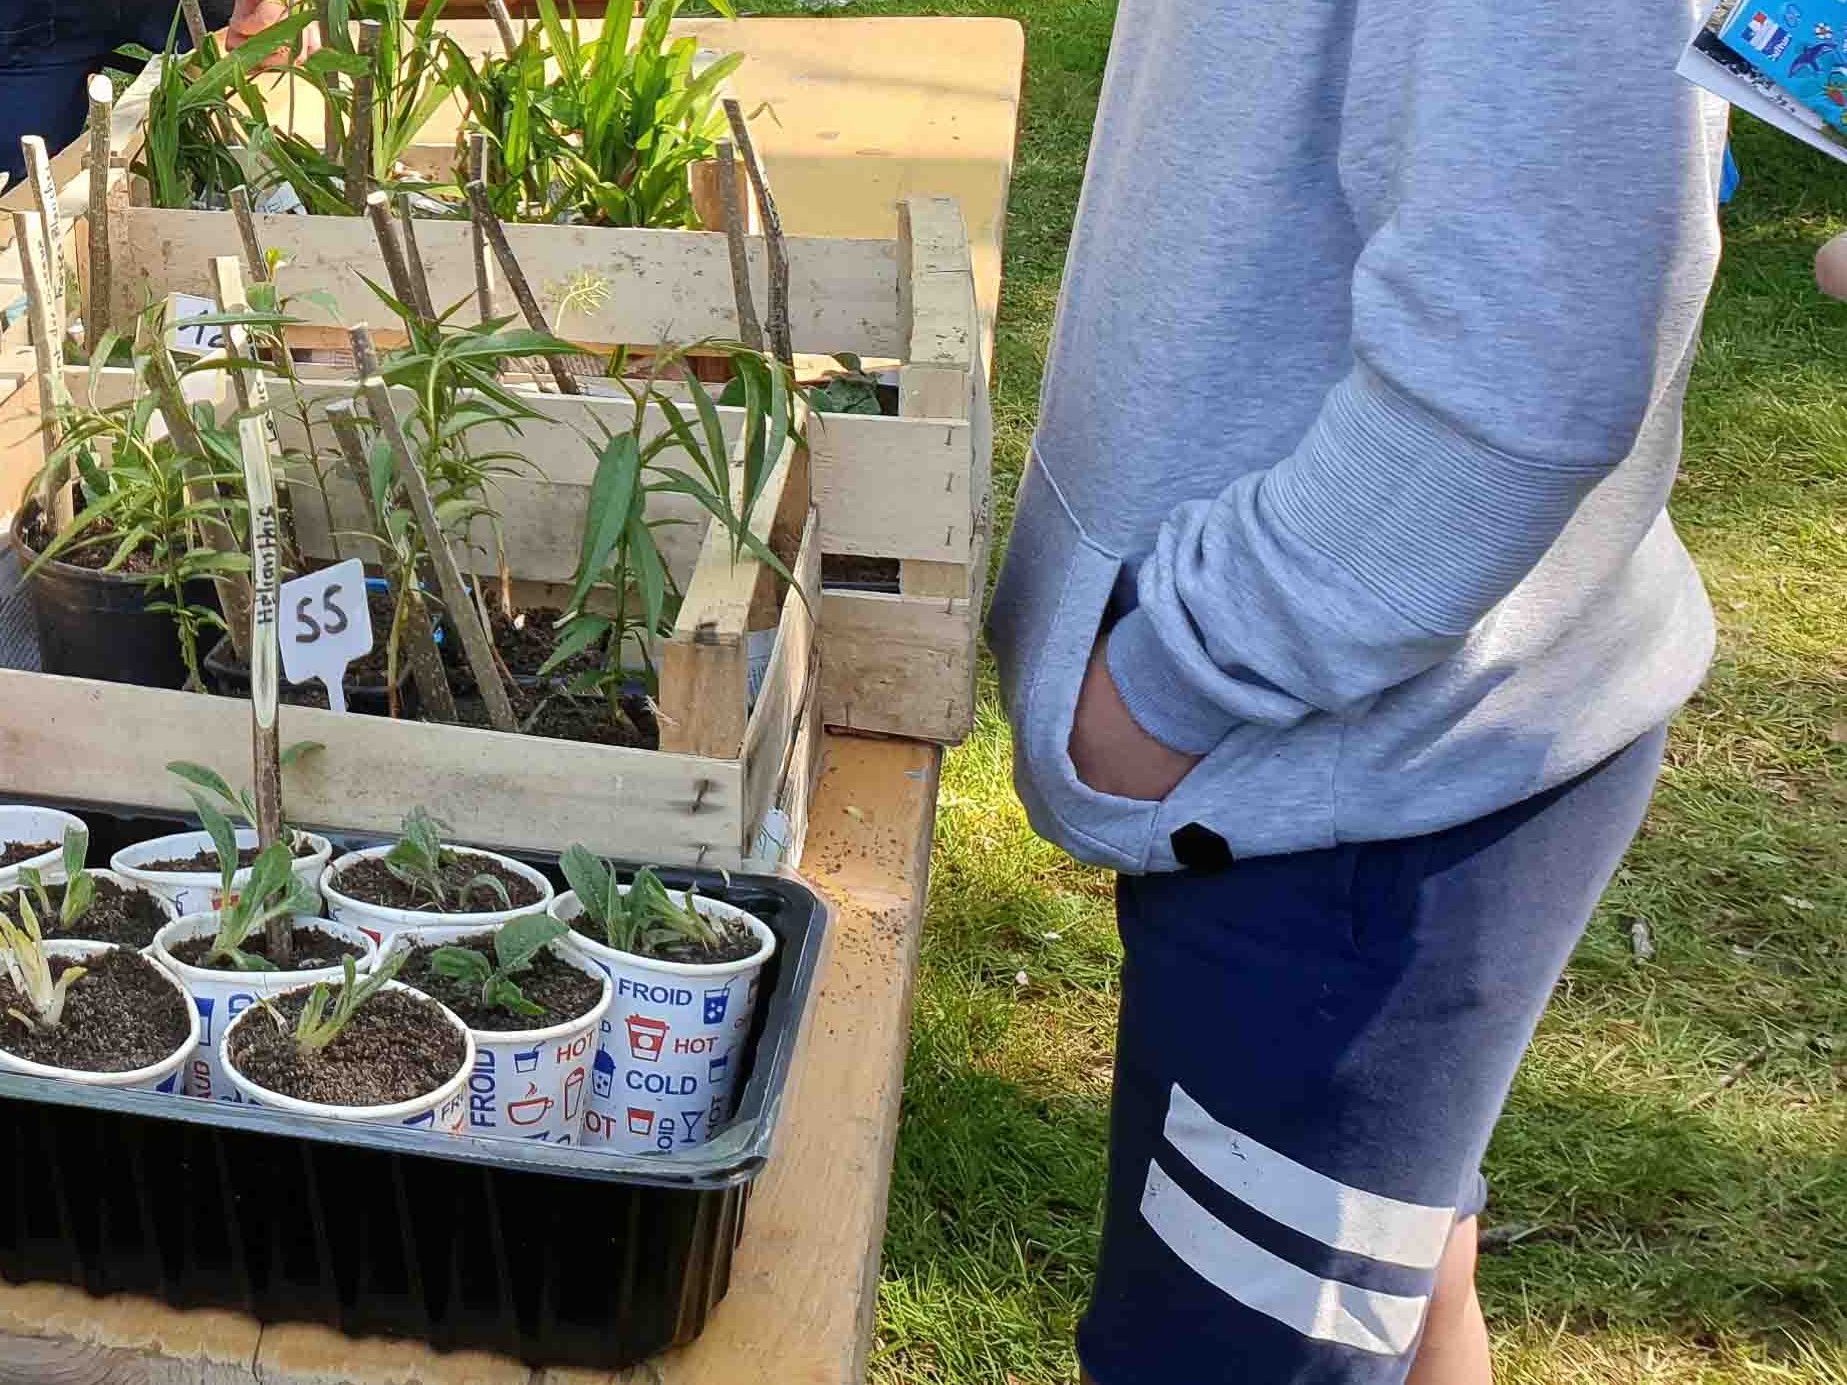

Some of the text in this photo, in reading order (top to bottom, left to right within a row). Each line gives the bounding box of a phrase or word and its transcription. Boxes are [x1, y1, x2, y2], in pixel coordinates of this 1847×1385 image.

[618, 978, 693, 1006] FROID
[556, 1030, 595, 1063] HOT
[674, 1036, 719, 1054] HOT
[469, 1048, 496, 1127] FROID
[625, 1069, 697, 1095] COLD
[585, 1109, 617, 1141] OT
